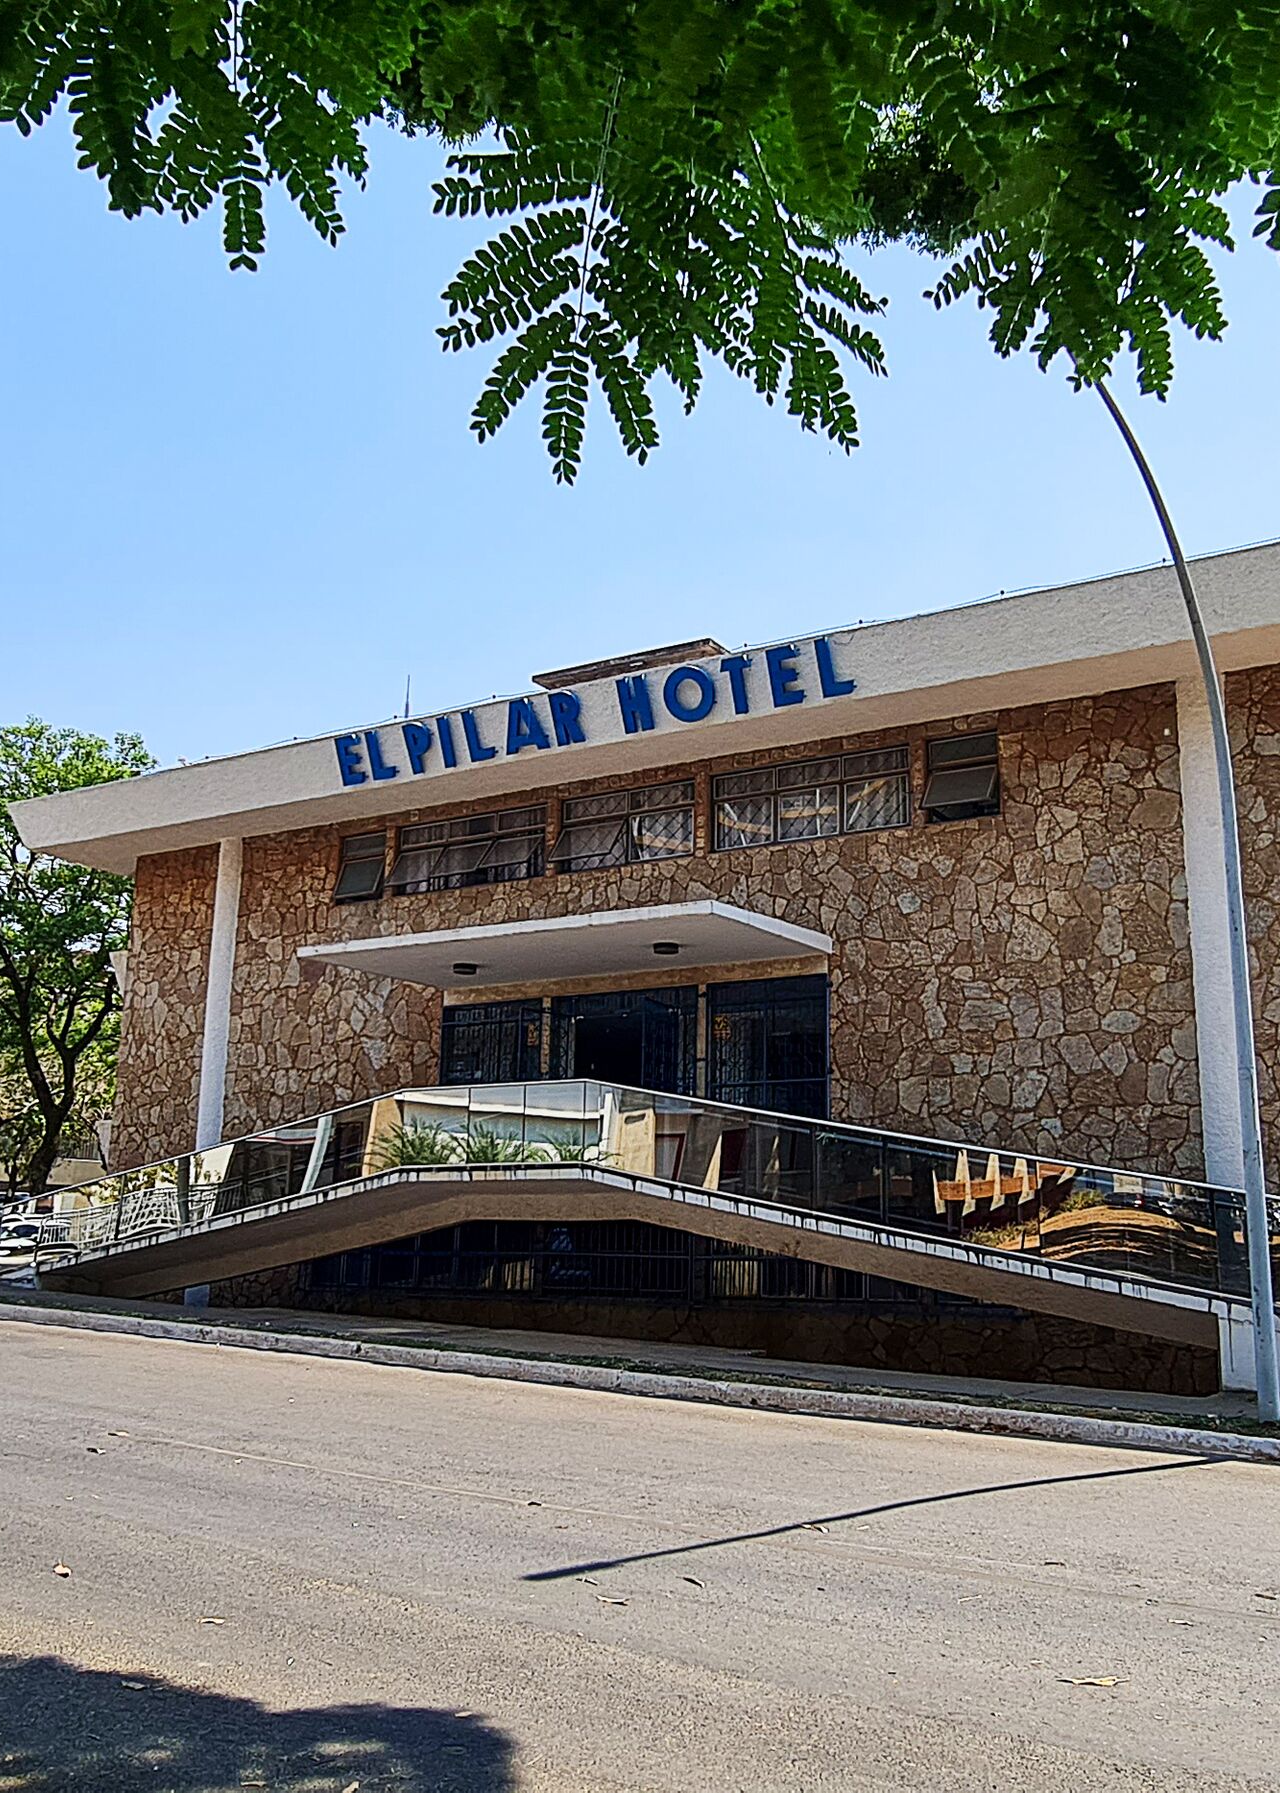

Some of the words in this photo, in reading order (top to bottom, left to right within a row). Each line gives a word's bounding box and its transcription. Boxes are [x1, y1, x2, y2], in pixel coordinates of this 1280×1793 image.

[335, 731, 398, 787] EL
[402, 690, 587, 775] PILAR
[615, 637, 857, 735] HOTEL
